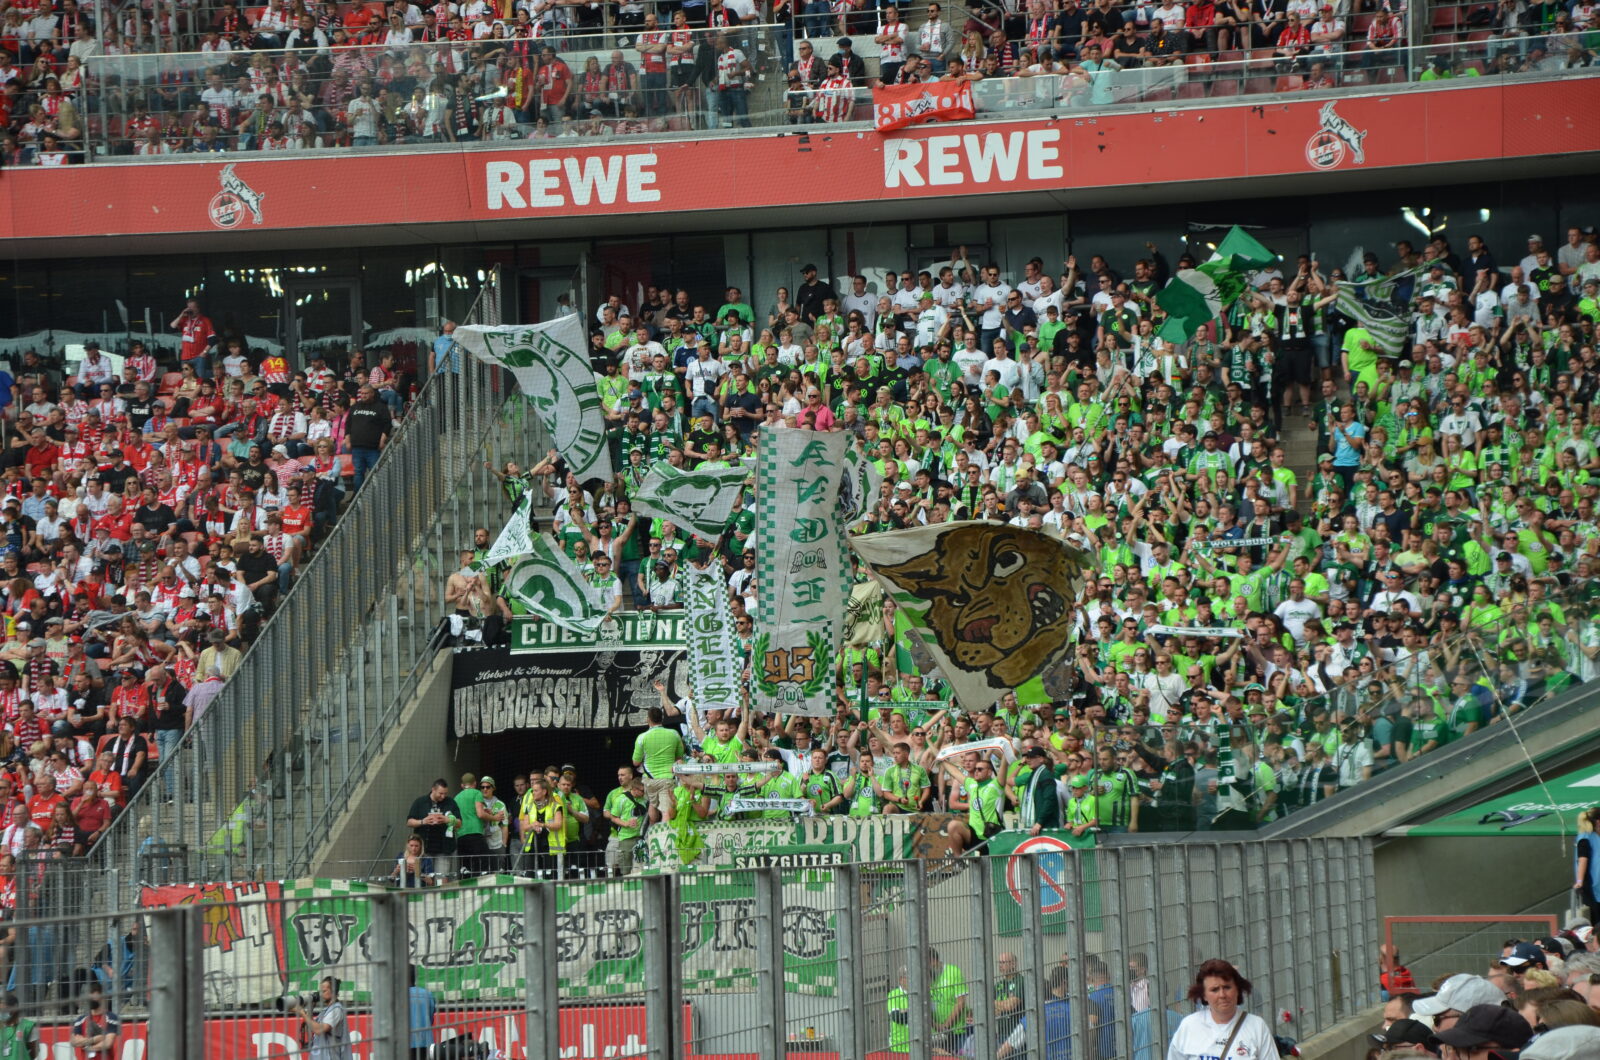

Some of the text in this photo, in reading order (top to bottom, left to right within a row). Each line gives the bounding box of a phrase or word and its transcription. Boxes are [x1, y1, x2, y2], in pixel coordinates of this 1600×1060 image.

[887, 129, 1064, 188] REWE
[486, 153, 661, 210] REWE
[268, 357, 284, 369] 14
[1210, 537, 1274, 549] WOLFSBURG
[475, 668, 513, 682] Hubert
[764, 647, 816, 684] 95
[454, 677, 594, 738] UNVERGESSEN
[735, 853, 842, 869] SALZGITTER
